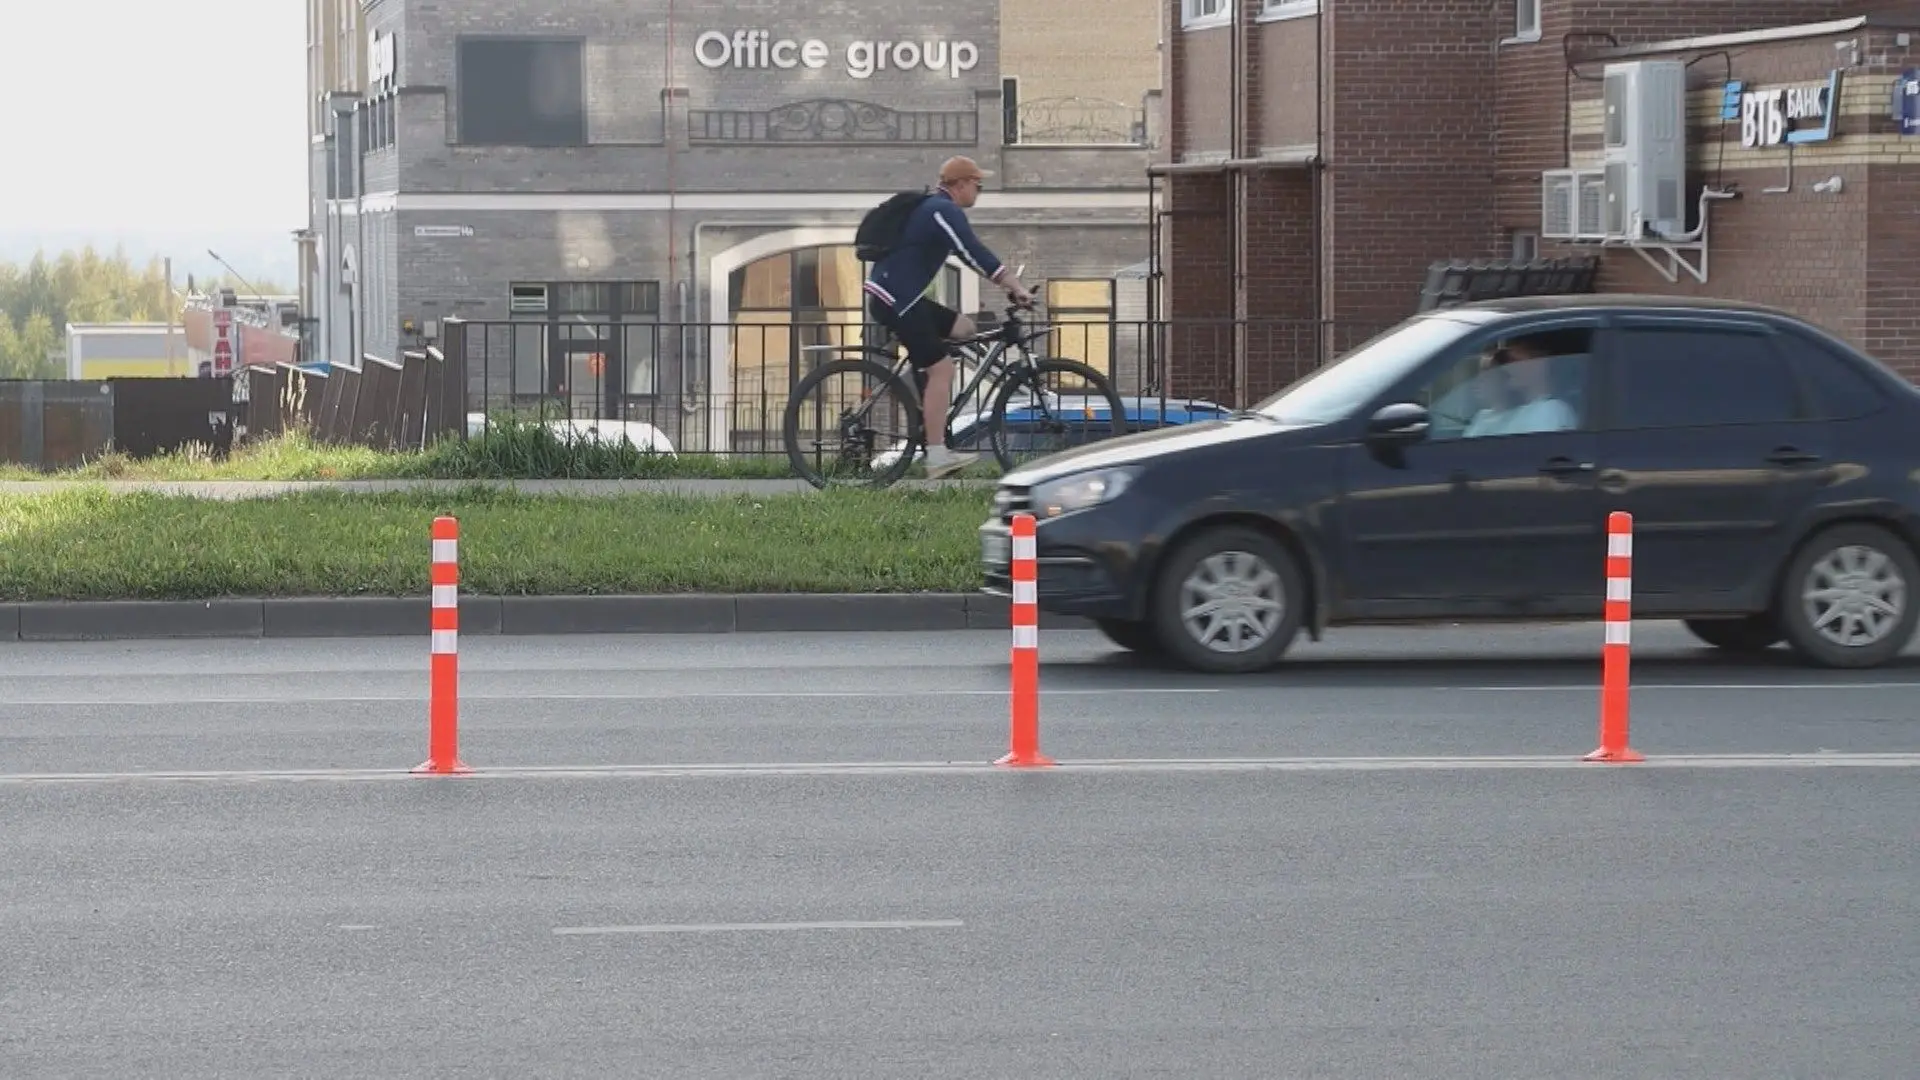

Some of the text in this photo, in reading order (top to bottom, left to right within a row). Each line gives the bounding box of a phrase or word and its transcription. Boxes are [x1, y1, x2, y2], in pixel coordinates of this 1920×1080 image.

[694, 29, 979, 79] Office group
[1742, 87, 1824, 147] ВТБ БАНК
